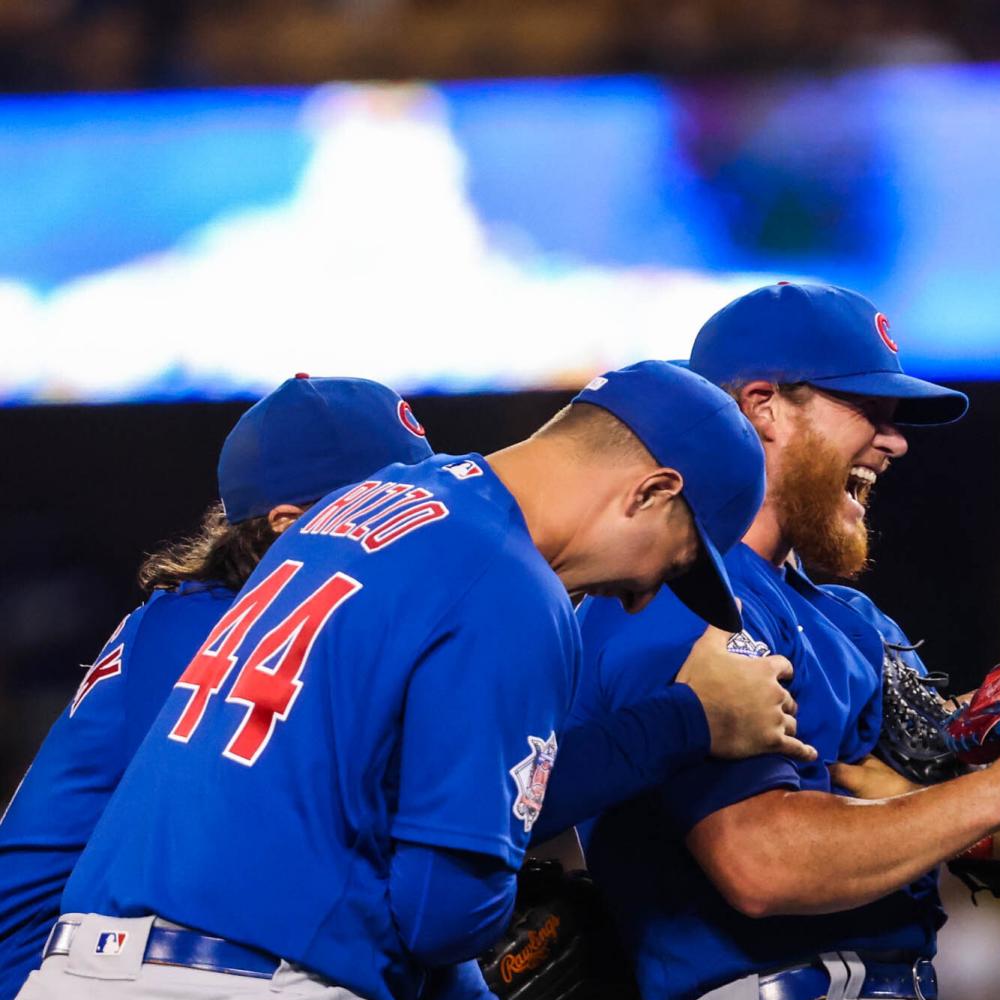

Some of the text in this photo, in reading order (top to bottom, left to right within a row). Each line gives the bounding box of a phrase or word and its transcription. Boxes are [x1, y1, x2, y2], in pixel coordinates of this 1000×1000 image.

[874, 312, 898, 354] C
[397, 400, 426, 438] C
[300, 480, 450, 553] RIZZO
[168, 559, 363, 767] 44
